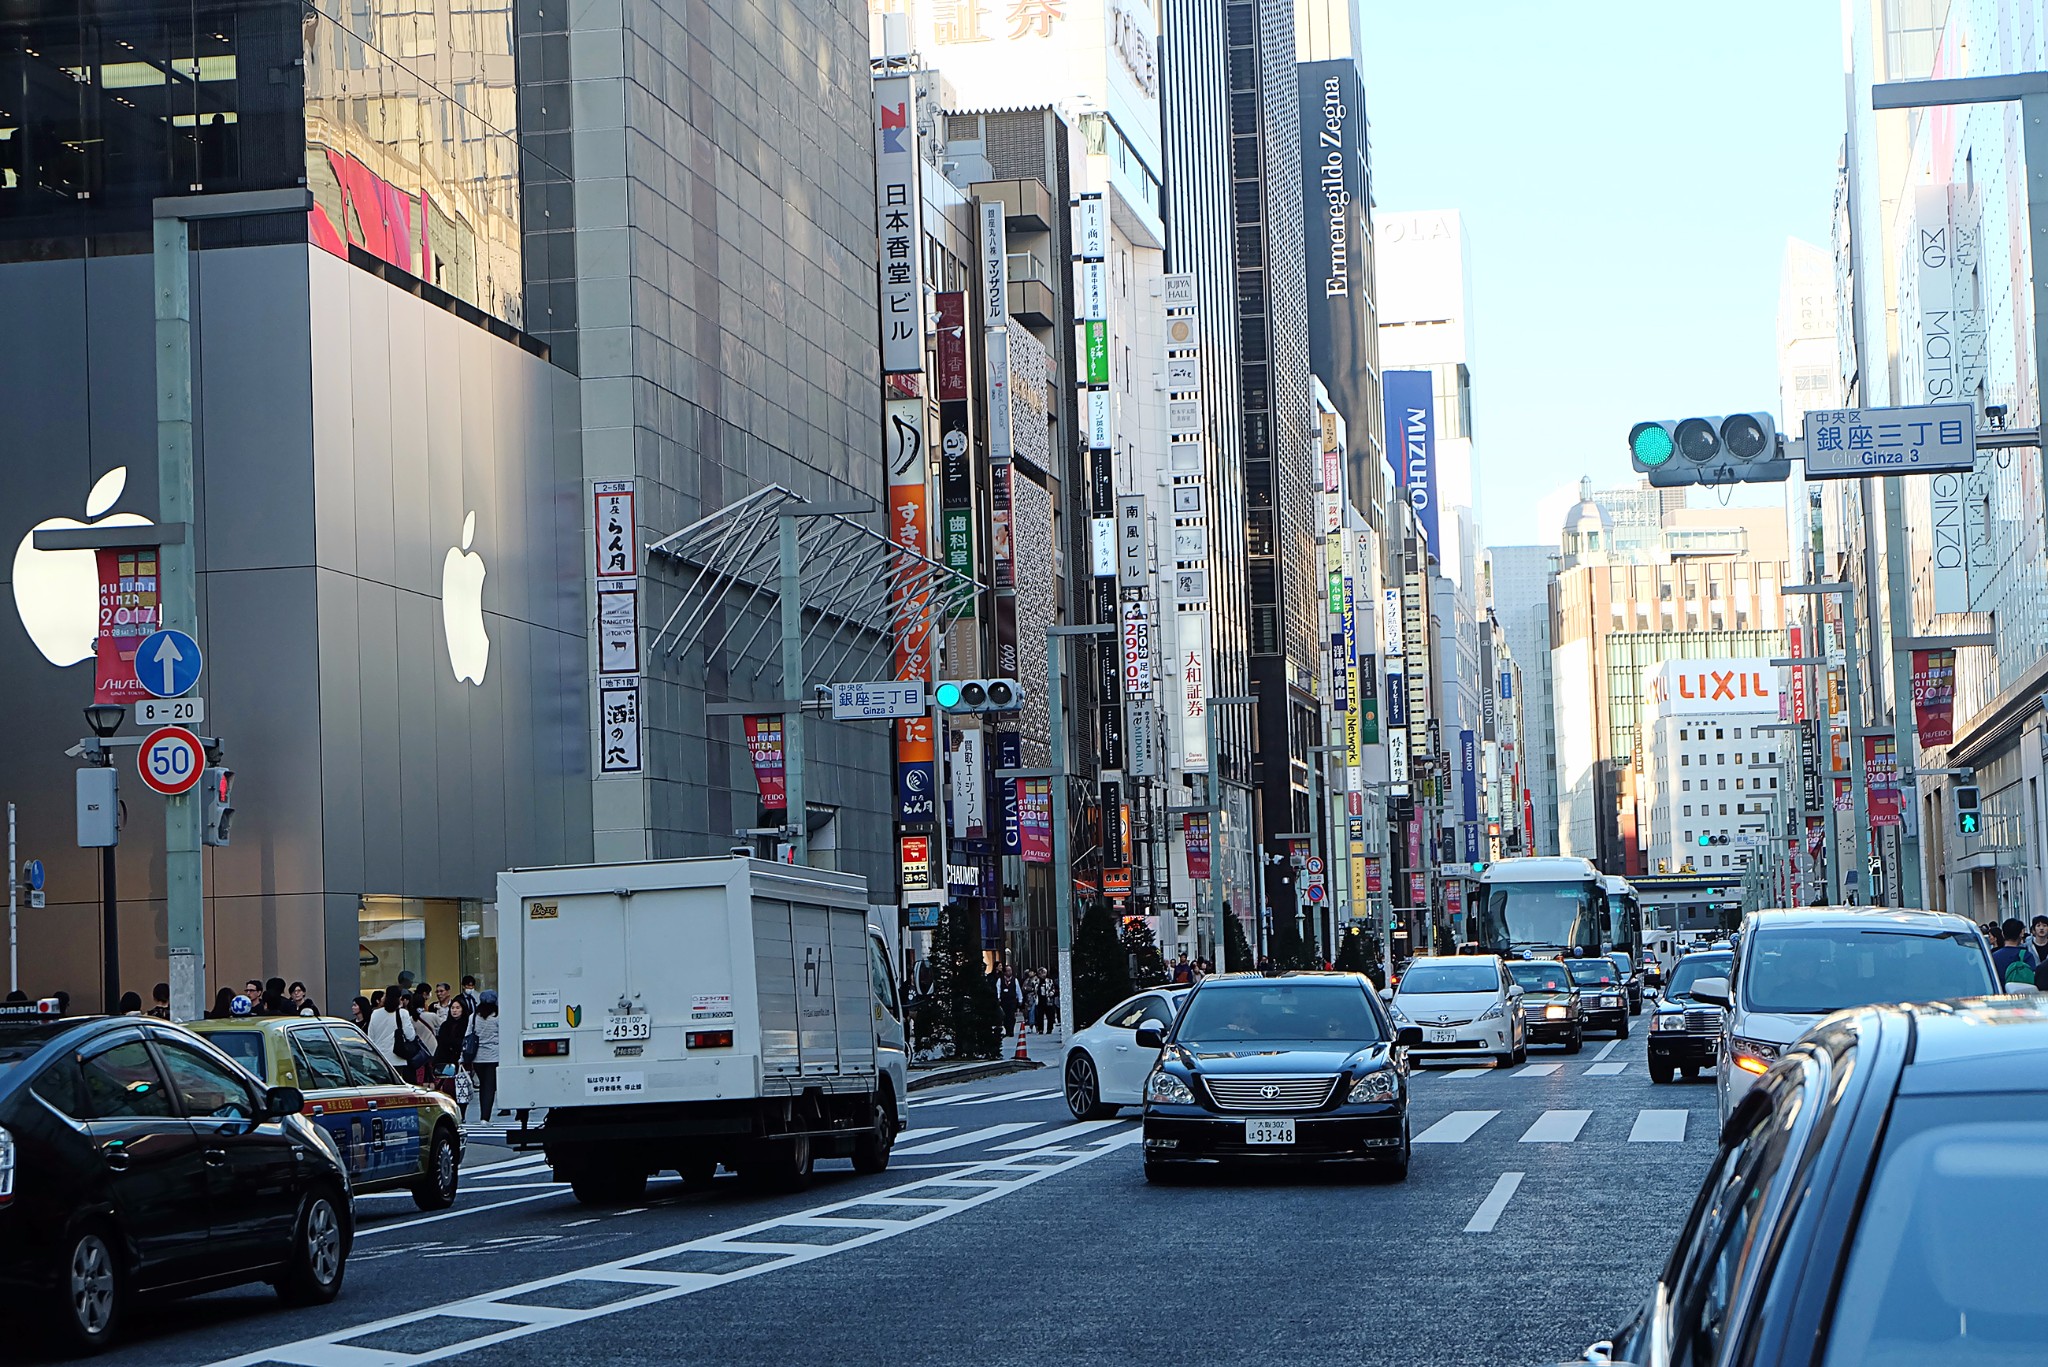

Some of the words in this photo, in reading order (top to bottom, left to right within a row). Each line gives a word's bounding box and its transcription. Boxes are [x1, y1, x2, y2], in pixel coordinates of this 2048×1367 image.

[1320, 76, 1347, 149] Zegna
[1087, 204, 1098, 252] 井上商会
[1321, 151, 1351, 299] Ermenegildo
[886, 184, 913, 341] 日本香堂ビル
[988, 260, 1000, 317] マツザワビル
[1091, 265, 1099, 318] 銀座中央通り眼科
[1167, 280, 1190, 290] JUJIYA
[1168, 290, 1189, 298] HALL
[1816, 411, 1862, 426] 中央区
[1817, 420, 1962, 451] 銀座三丁目
[944, 439, 962, 482] apish
[1407, 408, 1429, 511] MIZUHO
[1861, 452, 1903, 465] Ginza
[1910, 449, 1919, 462] 3
[995, 468, 1008, 478] 4F
[608, 518, 625, 571] らん月
[949, 516, 967, 566] 歯科室
[1126, 505, 1139, 578] 南風ビル
[100, 582, 156, 594] AUTUMN
[101, 595, 140, 606] GINZA
[100, 607, 155, 626] 2017
[950, 623, 958, 676] Samantha
[1138, 625, 1148, 658] 50分
[1125, 623, 1139, 692] 2990円
[1333, 645, 1347, 700] 洋服の青山
[98, 679, 144, 690] SHISEI
[606, 679, 634, 687] 地下1階
[1184, 651, 1204, 717] 大和証券
[1679, 670, 1769, 701] LIXIL
[1915, 670, 1953, 679] AUTUMN
[839, 689, 918, 706] 銀座三丁目
[1135, 701, 1145, 709] 3F
[1483, 686, 1494, 724] ALBION
[1915, 685, 1951, 700] 2017
[888, 705, 894, 713] 3
[607, 704, 629, 764] 酒の穴
[1347, 718, 1357, 763] Network.
[1921, 730, 1952, 741] SHISEIDO
[153, 746, 190, 775] 50
[1135, 726, 1144, 773] MIDORIYA
[1392, 737, 1403, 786] 椿屋珈琲
[1465, 742, 1473, 771] MIZUHO
[964, 740, 976, 827] 買取エージェント
[903, 800, 932, 814] らん月
[1019, 811, 1048, 820] 2017
[1467, 823, 1475, 853] ずほ銀行
[946, 864, 980, 886] CHAUMET
[1105, 873, 1129, 883] 吉野家
[1887, 833, 1897, 900] BVLGARI
[613, 1024, 647, 1037] 49-93
[1435, 1033, 1456, 1042] 75-77
[1249, 1132, 1256, 1140] は
[1256, 1129, 1293, 1144] 93-48
